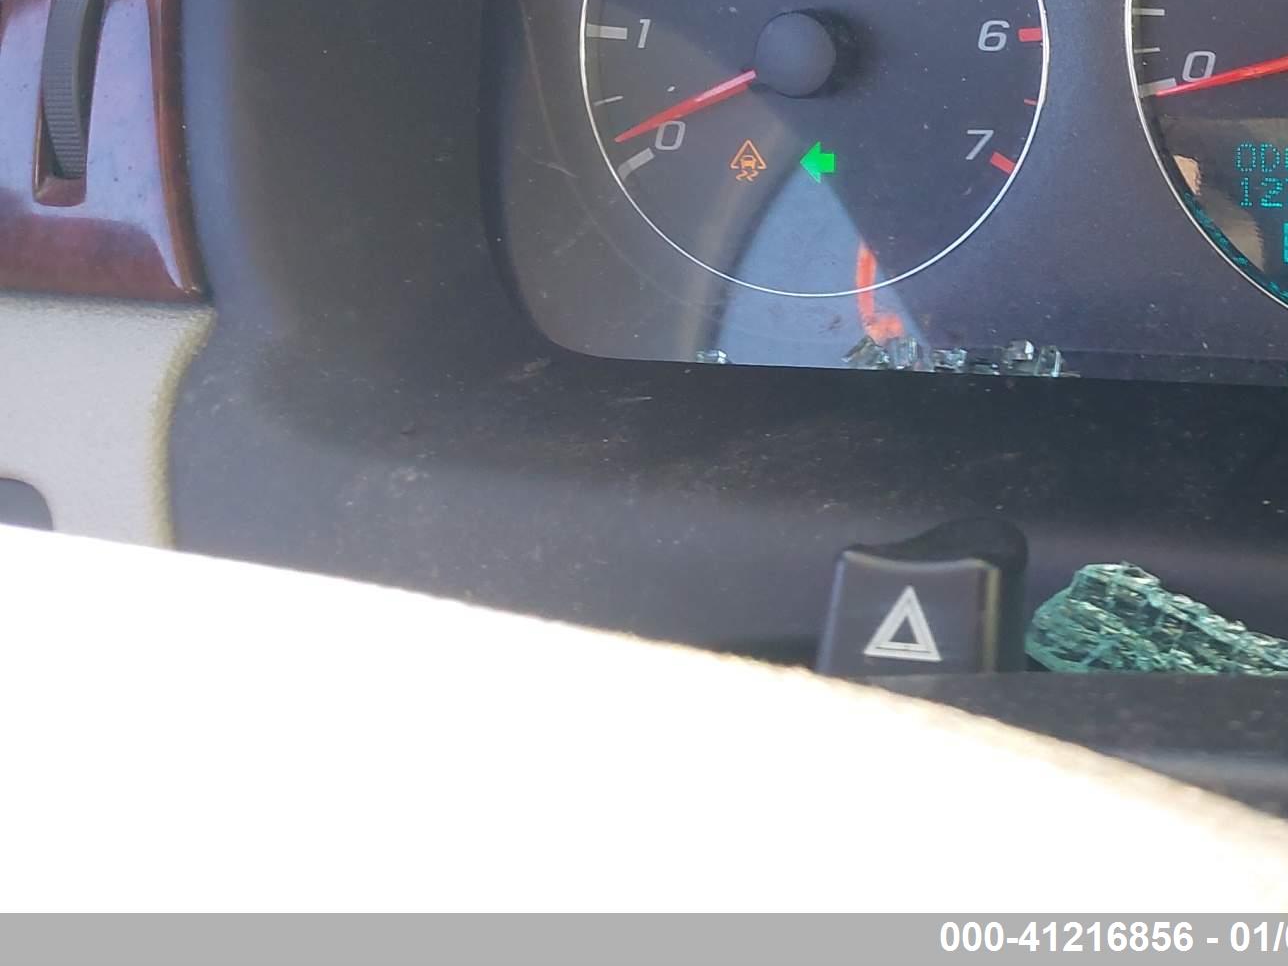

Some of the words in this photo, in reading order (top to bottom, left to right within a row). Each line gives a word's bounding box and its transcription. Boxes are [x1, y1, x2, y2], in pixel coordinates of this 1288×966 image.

[636, 18, 652, 49] 1
[976, 20, 1008, 52] 6
[1181, 51, 1217, 84] 0
[654, 120, 687, 151] 0
[965, 129, 994, 161] 7
